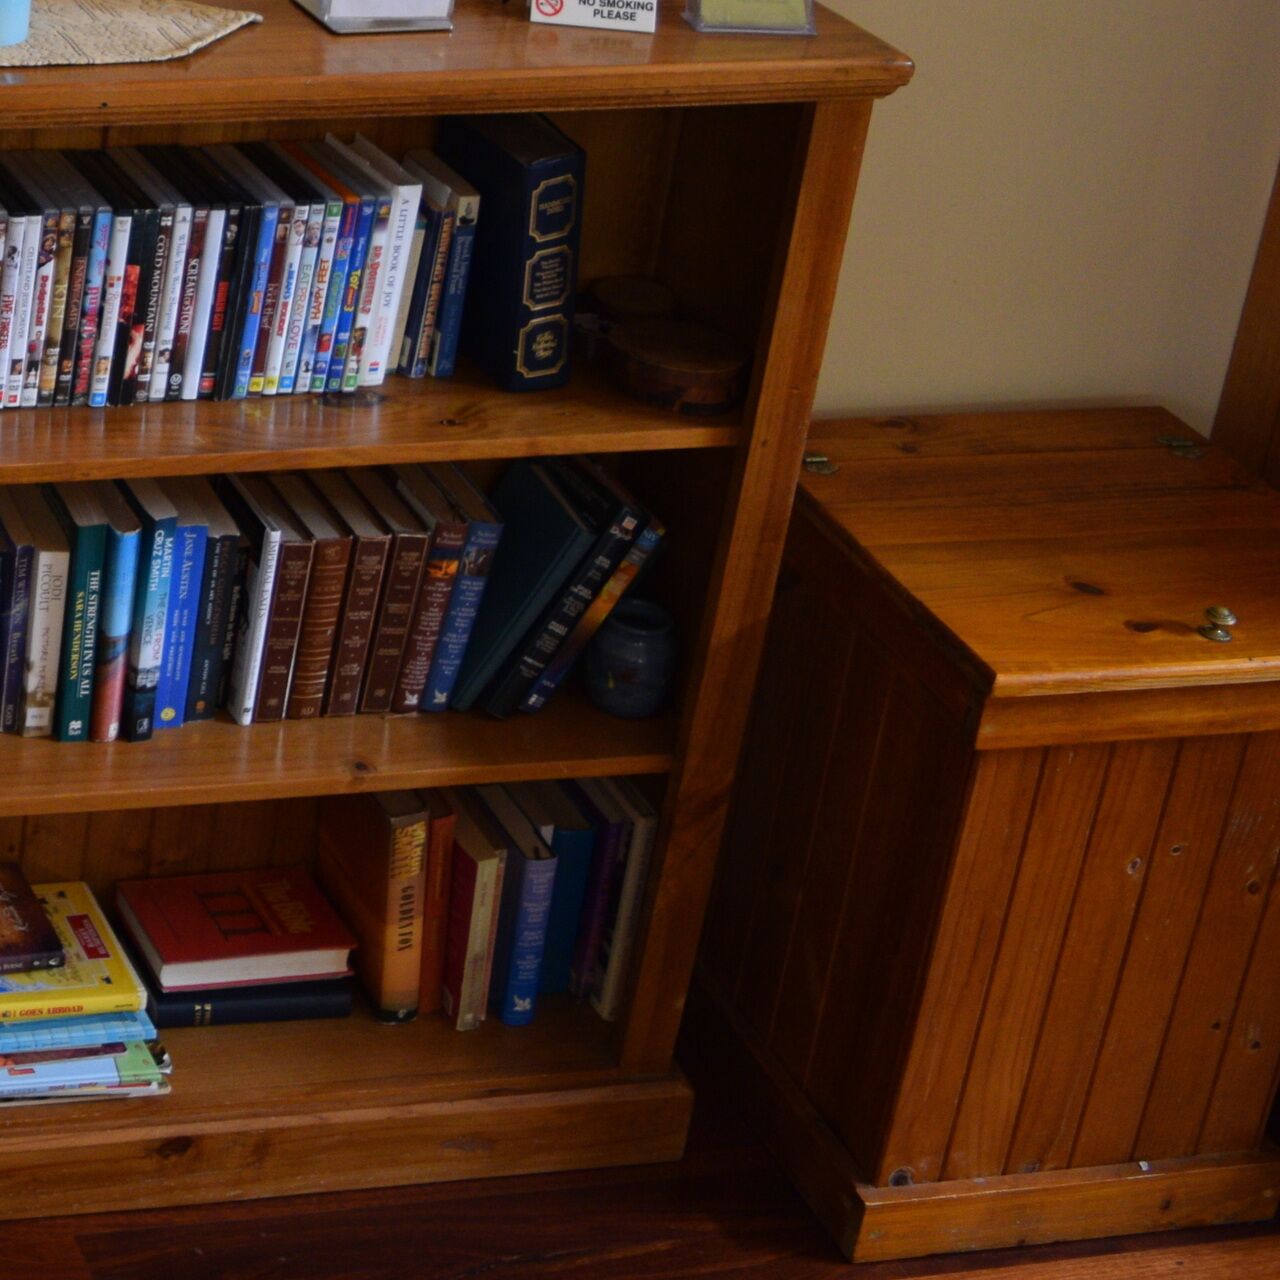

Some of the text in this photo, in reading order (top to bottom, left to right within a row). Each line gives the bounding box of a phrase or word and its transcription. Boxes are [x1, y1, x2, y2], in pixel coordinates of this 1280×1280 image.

[593, 9, 637, 21] PLEASE
[144, 235, 166, 332] COLD MOUNTAIN
[310, 286, 323, 320] HAPPY
[1, 295, 14, 314] FIVE
[288, 264, 312, 350] EAT LOVE
[17, 557, 27, 577] TIM
[149, 529, 165, 591] CRUZ SMITH
[161, 537, 174, 578] MARTIN
[179, 532, 197, 600] JANE AUSTEN
[38, 563, 52, 613] PICOULT
[51, 575, 63, 603] JODI
[69, 591, 85, 680] SARA HENDERSON
[79, 570, 101, 697] THE STRENGTH IN US ALL
[143, 614, 154, 645] VENICE
[19, 1007, 43, 1017] GOES
[47, 1005, 83, 1016] ABROAD
